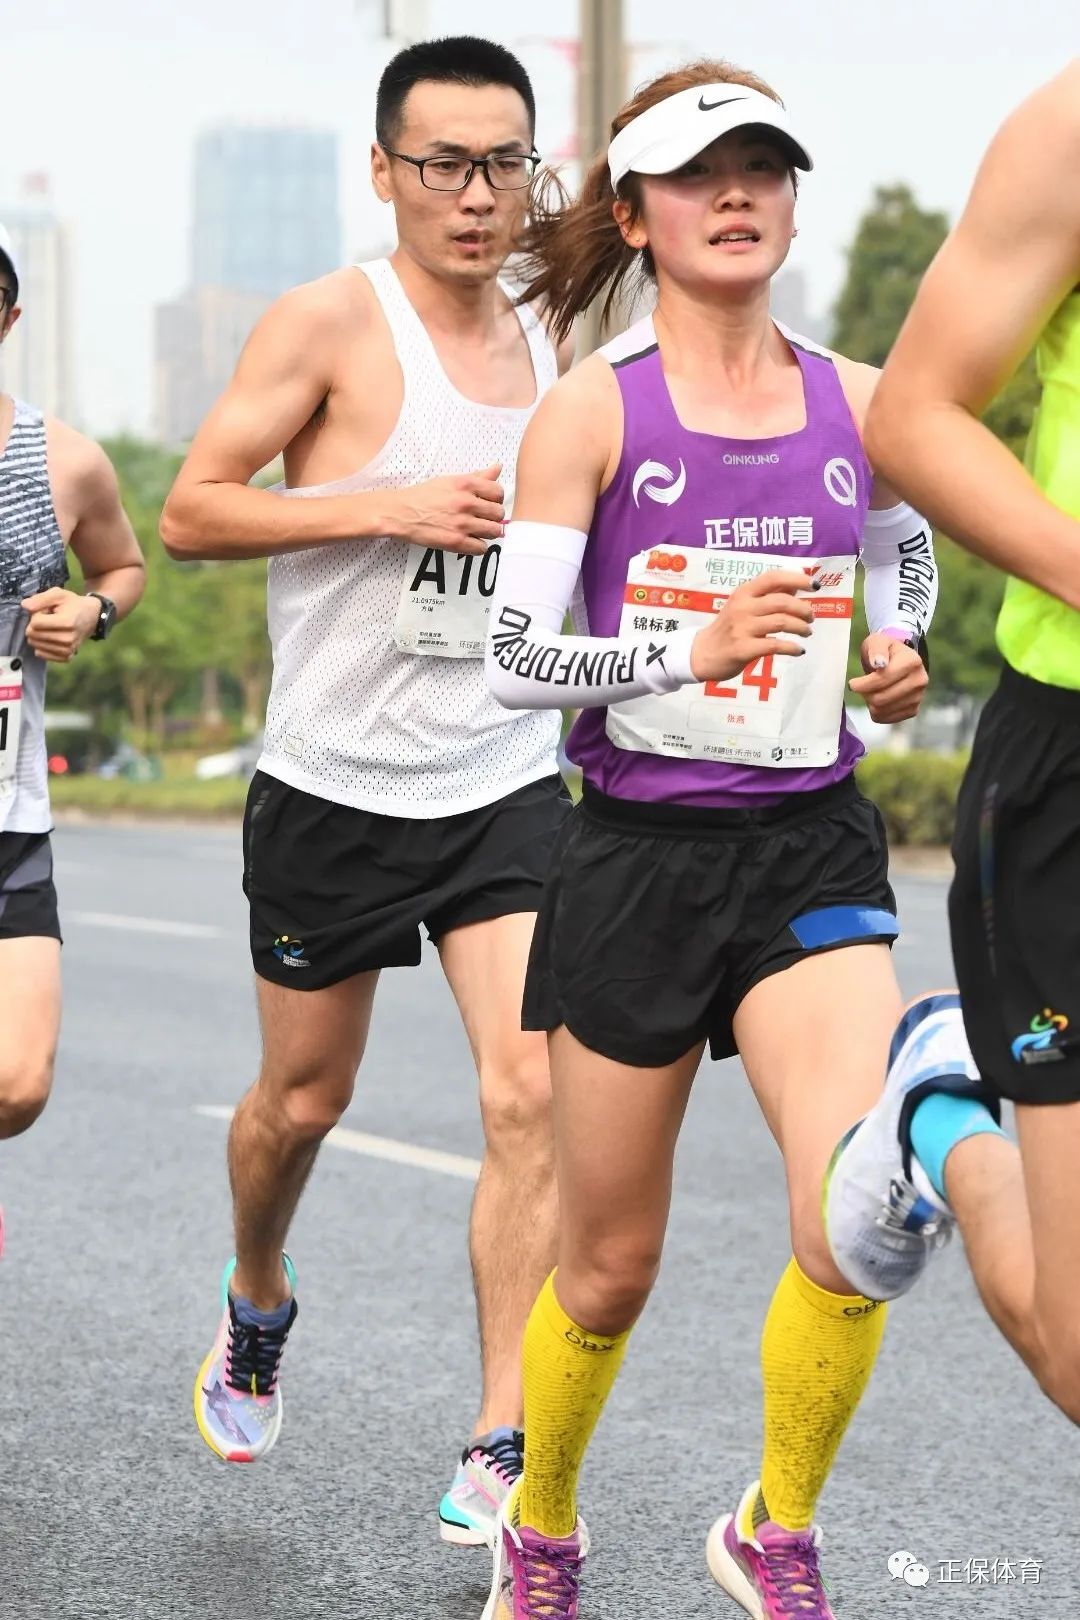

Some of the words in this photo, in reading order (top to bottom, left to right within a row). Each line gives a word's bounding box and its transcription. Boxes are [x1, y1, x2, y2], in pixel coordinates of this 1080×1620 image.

[722, 453, 780, 465] QINKUNG
[703, 516, 813, 549] 正保体育
[633, 615, 679, 633] 锦标赛
[564, 1330, 616, 1352] OBX
